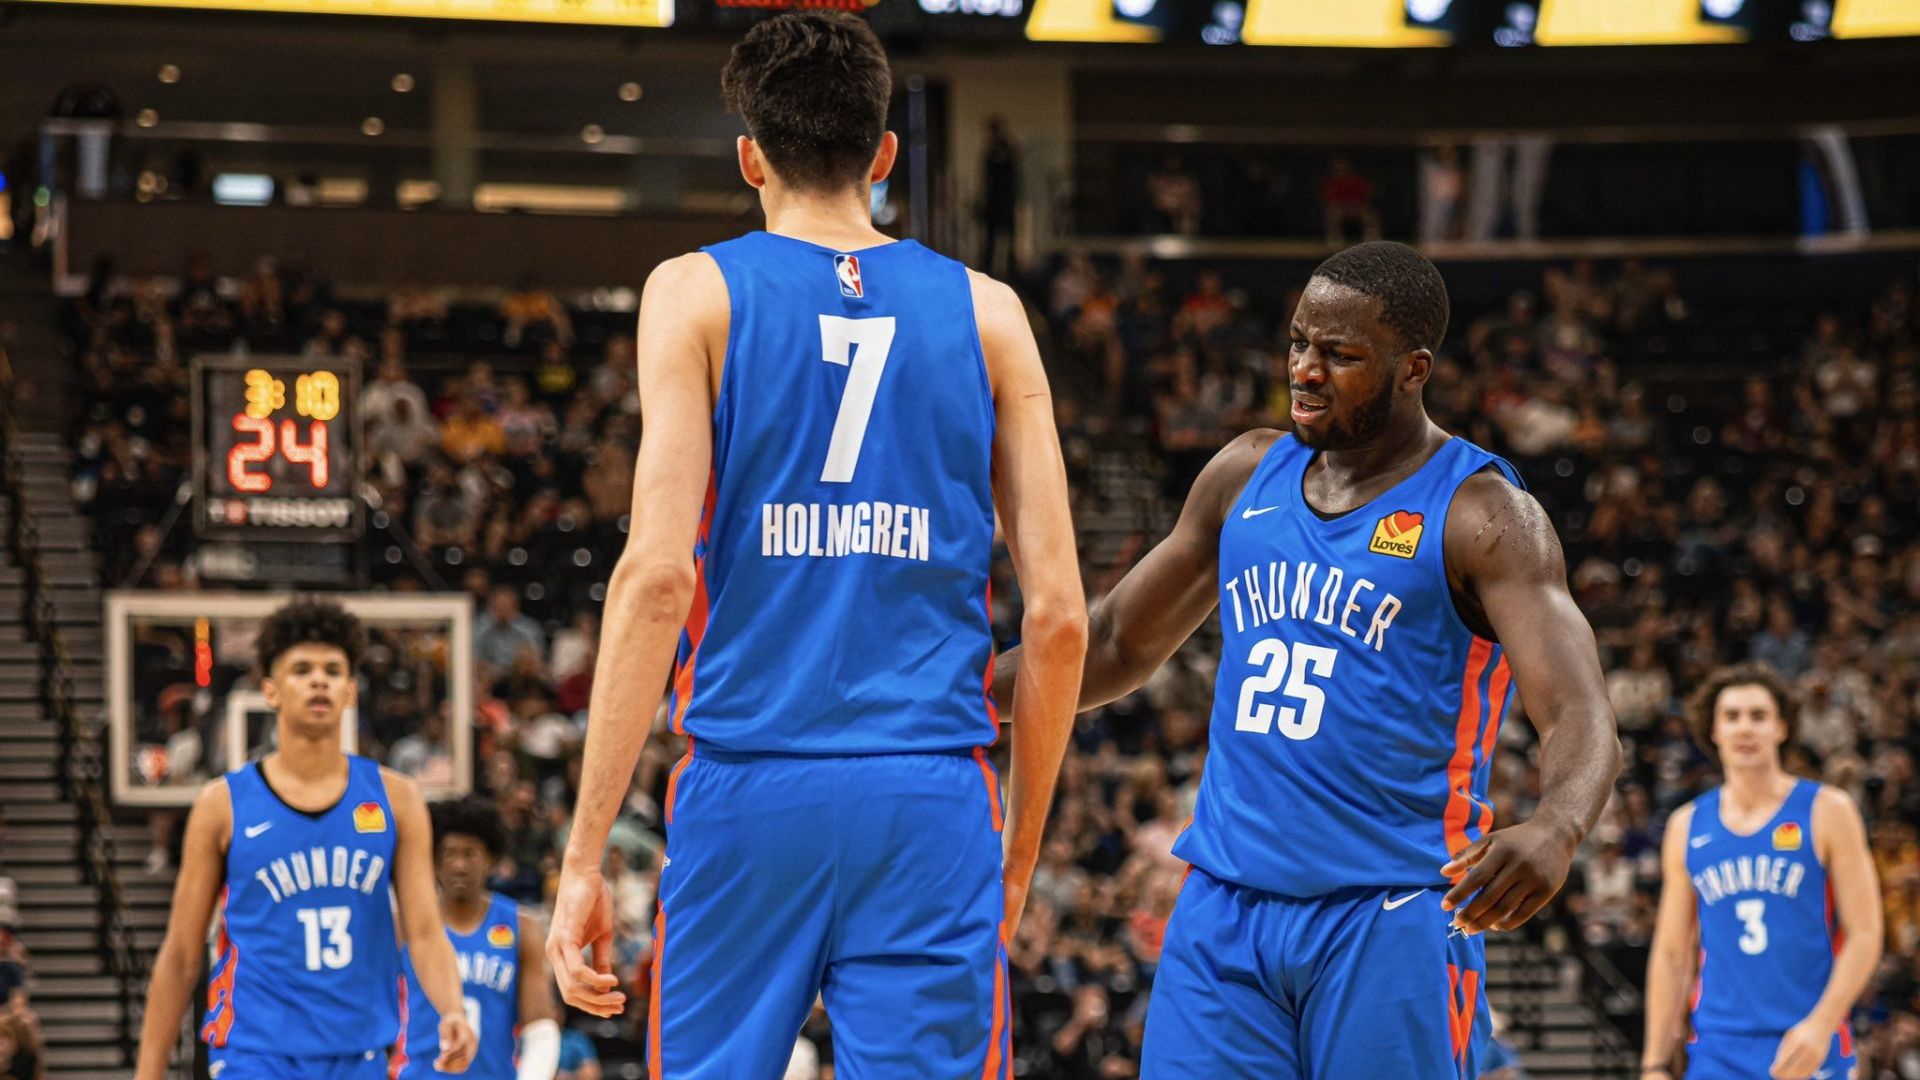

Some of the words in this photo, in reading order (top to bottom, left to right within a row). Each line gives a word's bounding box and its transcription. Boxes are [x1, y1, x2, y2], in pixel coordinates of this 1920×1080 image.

[245, 369, 340, 420] 3:10
[818, 314, 896, 483] 7
[228, 413, 328, 492] 24
[761, 501, 930, 561] HOLMGREN
[1226, 561, 1402, 652] THUNDER
[1235, 638, 1338, 740] 25
[255, 846, 385, 903] THUNDER
[1694, 854, 1805, 906] THUNDER
[296, 906, 352, 971] 13
[1735, 899, 1768, 955] 3
